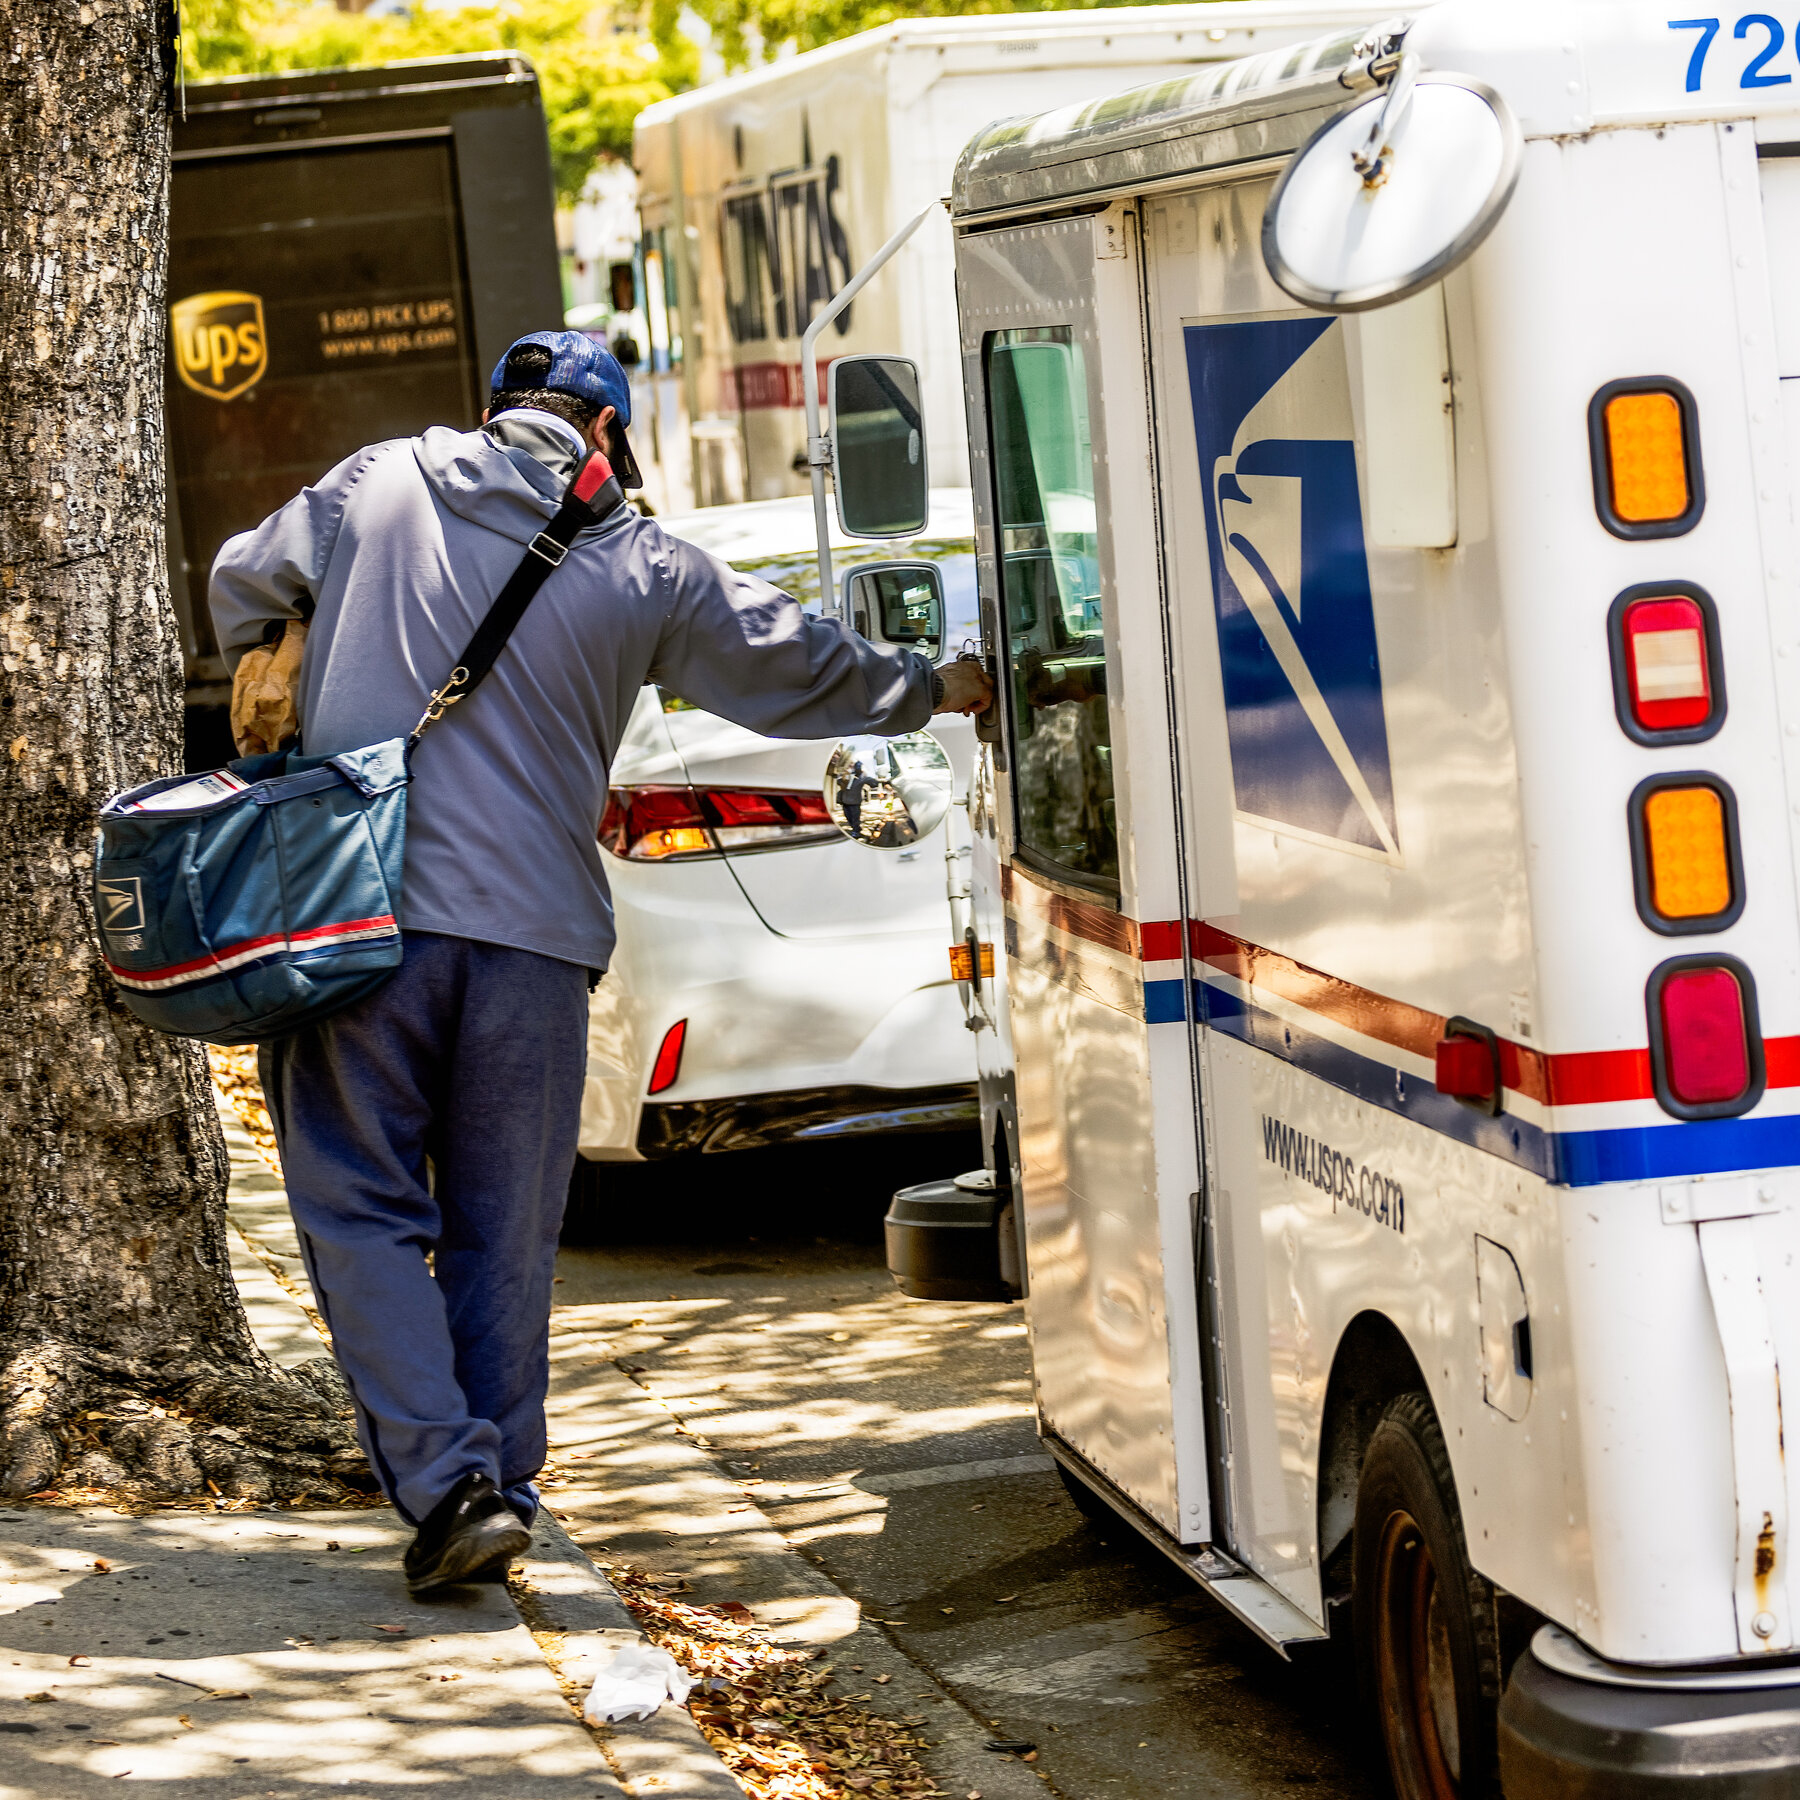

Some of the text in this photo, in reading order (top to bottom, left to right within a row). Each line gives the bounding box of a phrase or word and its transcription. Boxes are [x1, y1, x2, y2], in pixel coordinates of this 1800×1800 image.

[1667, 14, 1800, 92] 72
[320, 300, 455, 333] 1 800 PICK UPS
[322, 328, 456, 357] www.ups.com
[183, 322, 262, 385] ups
[1262, 1113, 1404, 1234] www.usps.com
